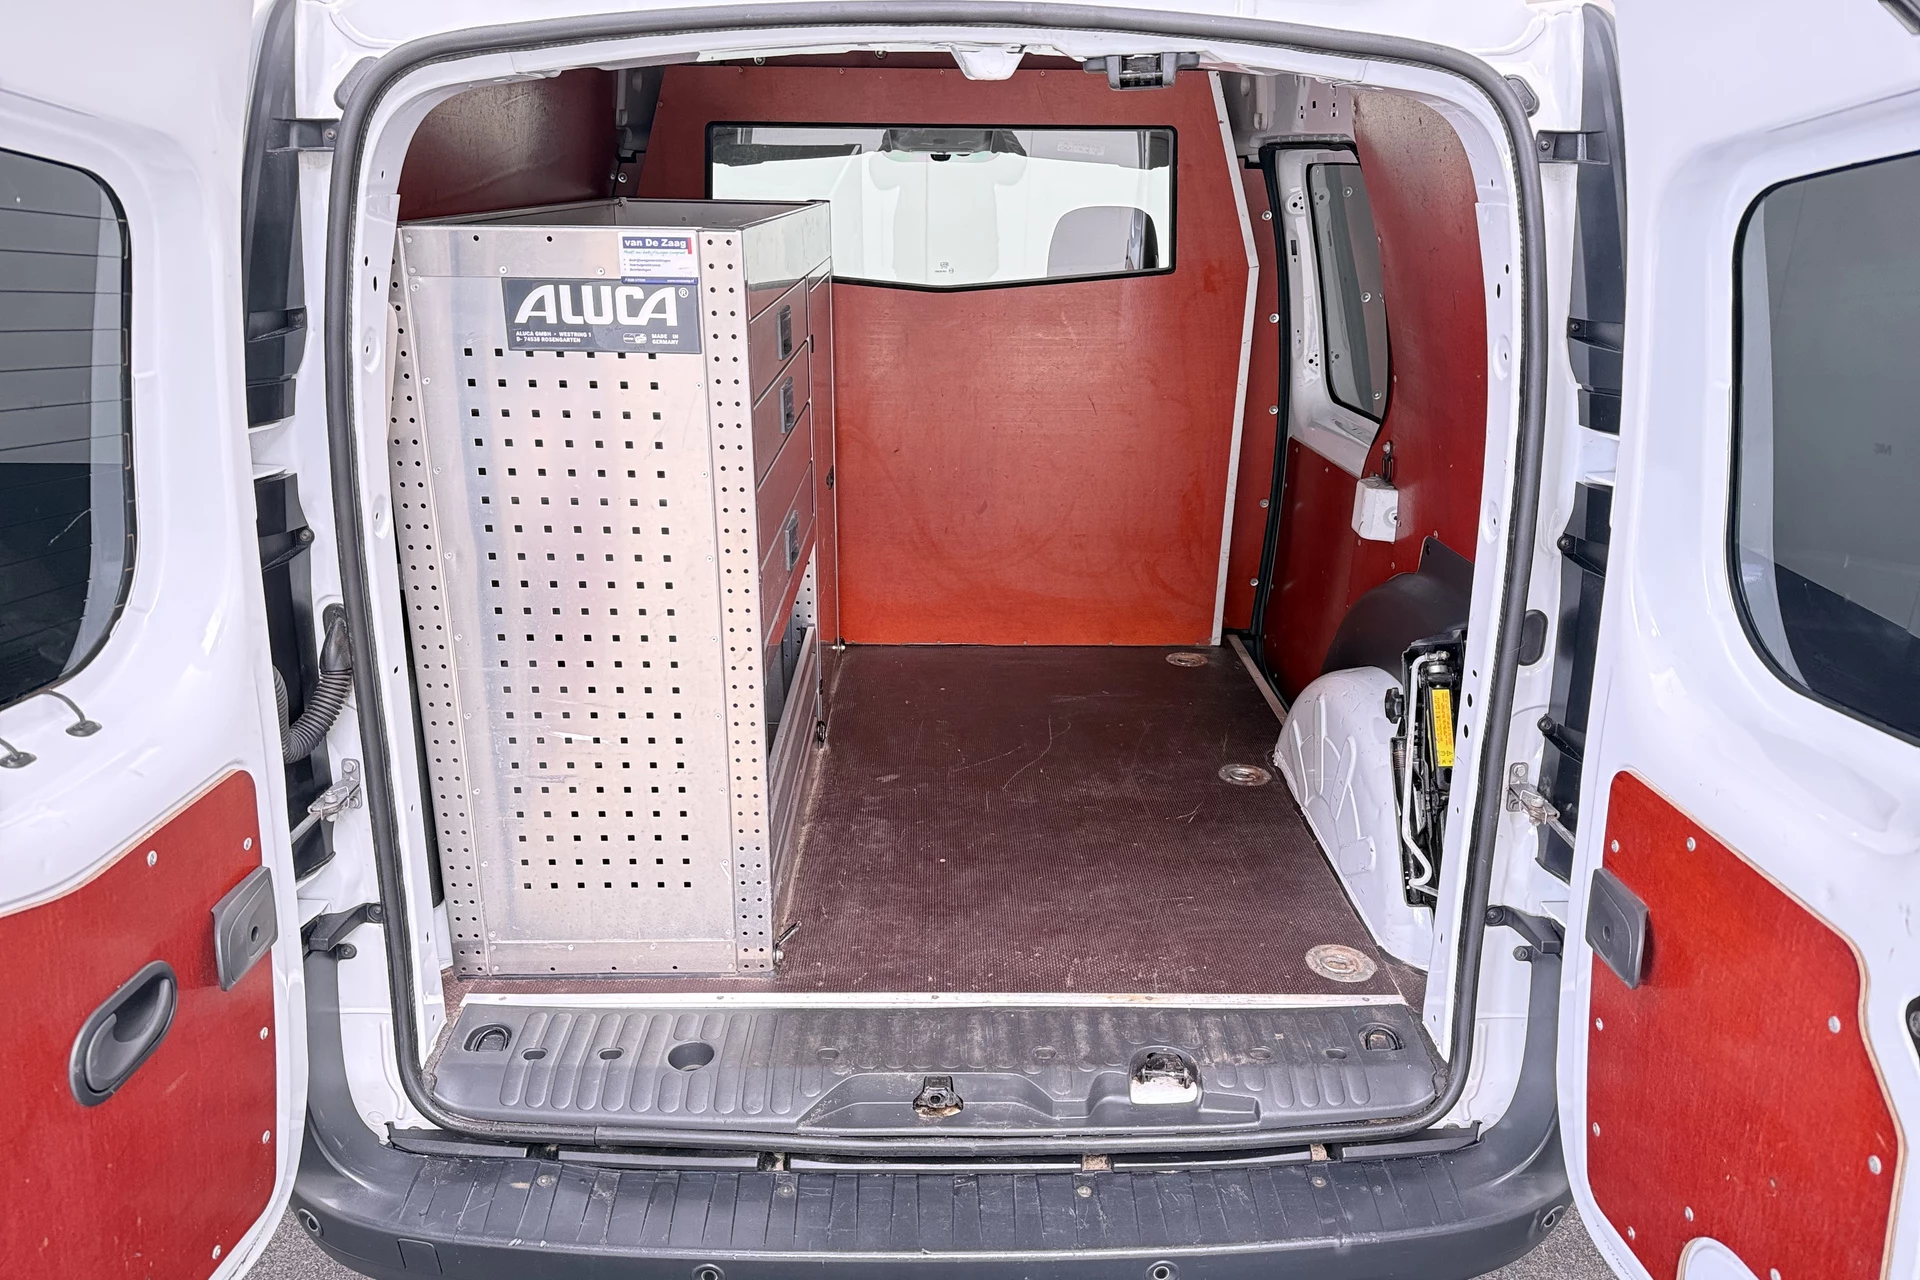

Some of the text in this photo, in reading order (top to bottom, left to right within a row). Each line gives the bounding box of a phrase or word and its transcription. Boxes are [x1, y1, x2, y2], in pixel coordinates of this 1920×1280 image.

[624, 238, 687, 249] van De Zaag
[514, 284, 678, 326] ALUCA
